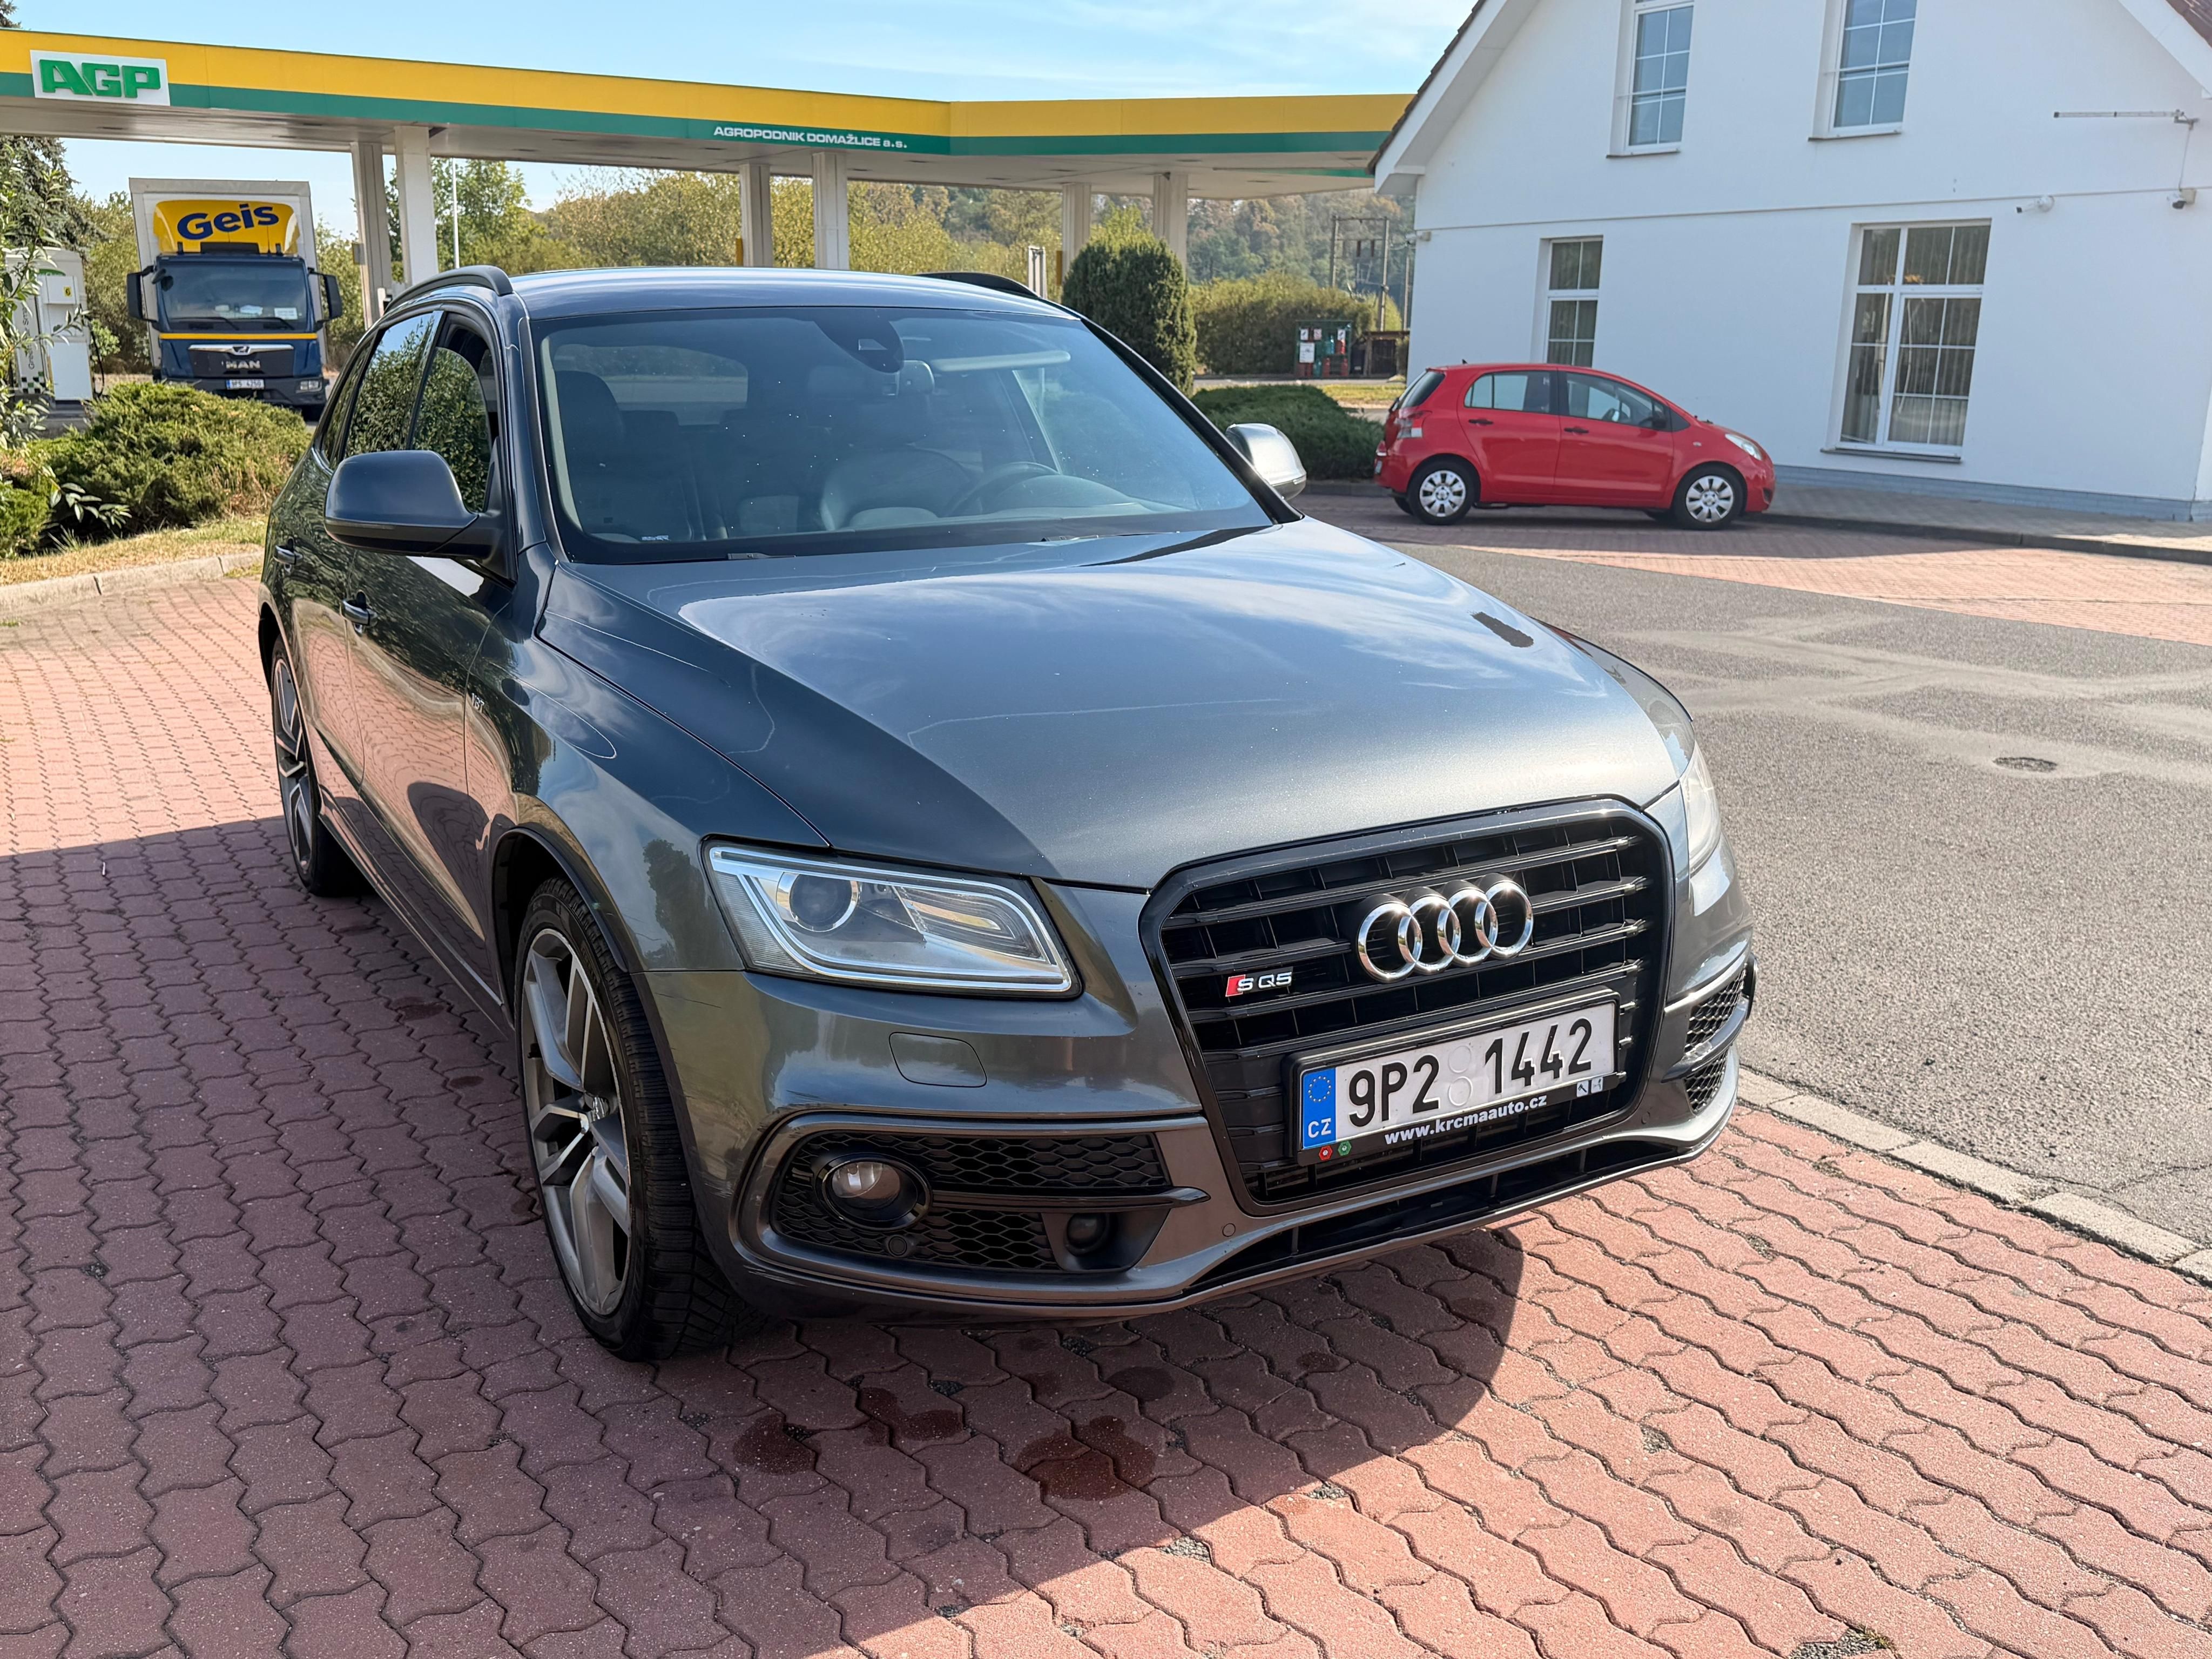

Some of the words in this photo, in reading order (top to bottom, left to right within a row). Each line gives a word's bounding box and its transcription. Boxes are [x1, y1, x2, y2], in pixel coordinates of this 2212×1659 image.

[39, 59, 161, 98] AGP
[713, 126, 805, 142] AGROPODNIK
[807, 133, 881, 146] DOMAŽLICE
[882, 140, 907, 149] a.s.
[177, 203, 279, 240] Geis
[226, 360, 260, 369] MAN
[1308, 1117, 1331, 1138] CZ
[1349, 1055, 1440, 1128] 9P2
[1485, 1018, 1593, 1094] 1442
[1385, 1095, 1547, 1145] www.krcmaauto.cz
